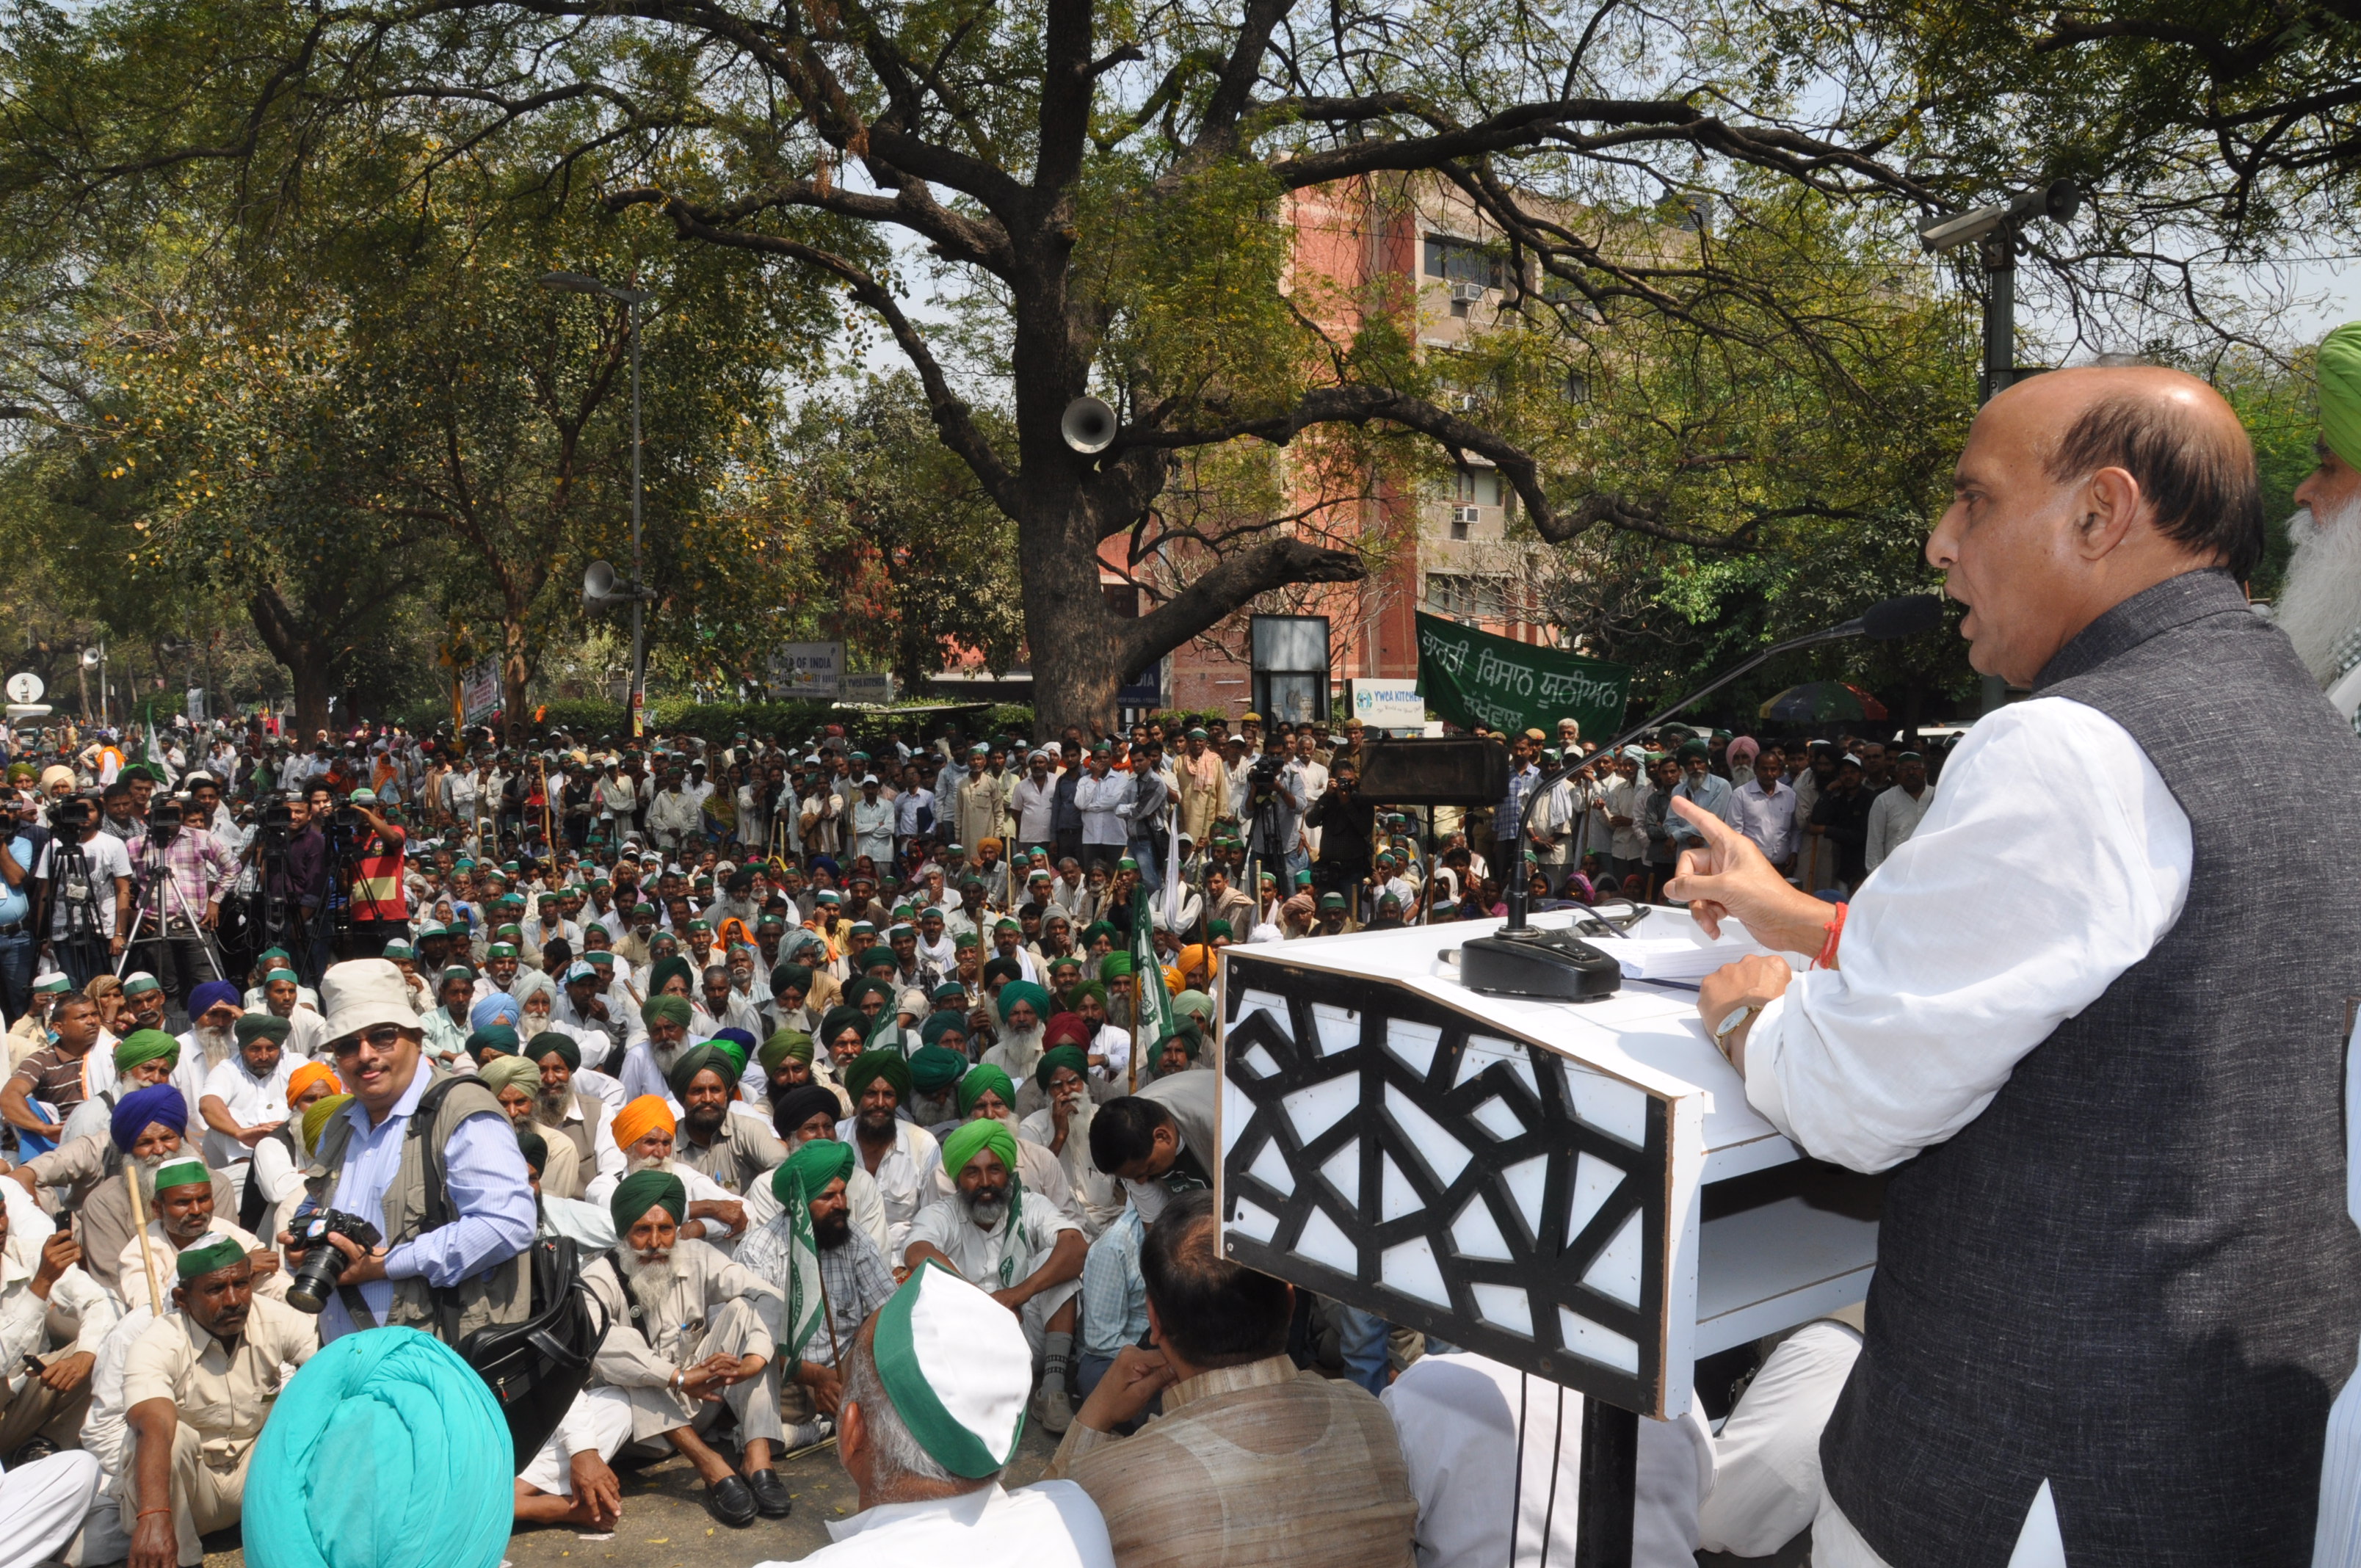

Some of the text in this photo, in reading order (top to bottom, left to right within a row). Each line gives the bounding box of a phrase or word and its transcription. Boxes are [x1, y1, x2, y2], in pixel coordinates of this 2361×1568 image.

[797, 657, 807, 669] OF
[810, 657, 832, 669] INDIA
[1423, 629, 1469, 676] ਭਾਰਤੀ
[1475, 647, 1534, 697] ਕਿਸਾਨ
[1374, 690, 1394, 702] YWCA
